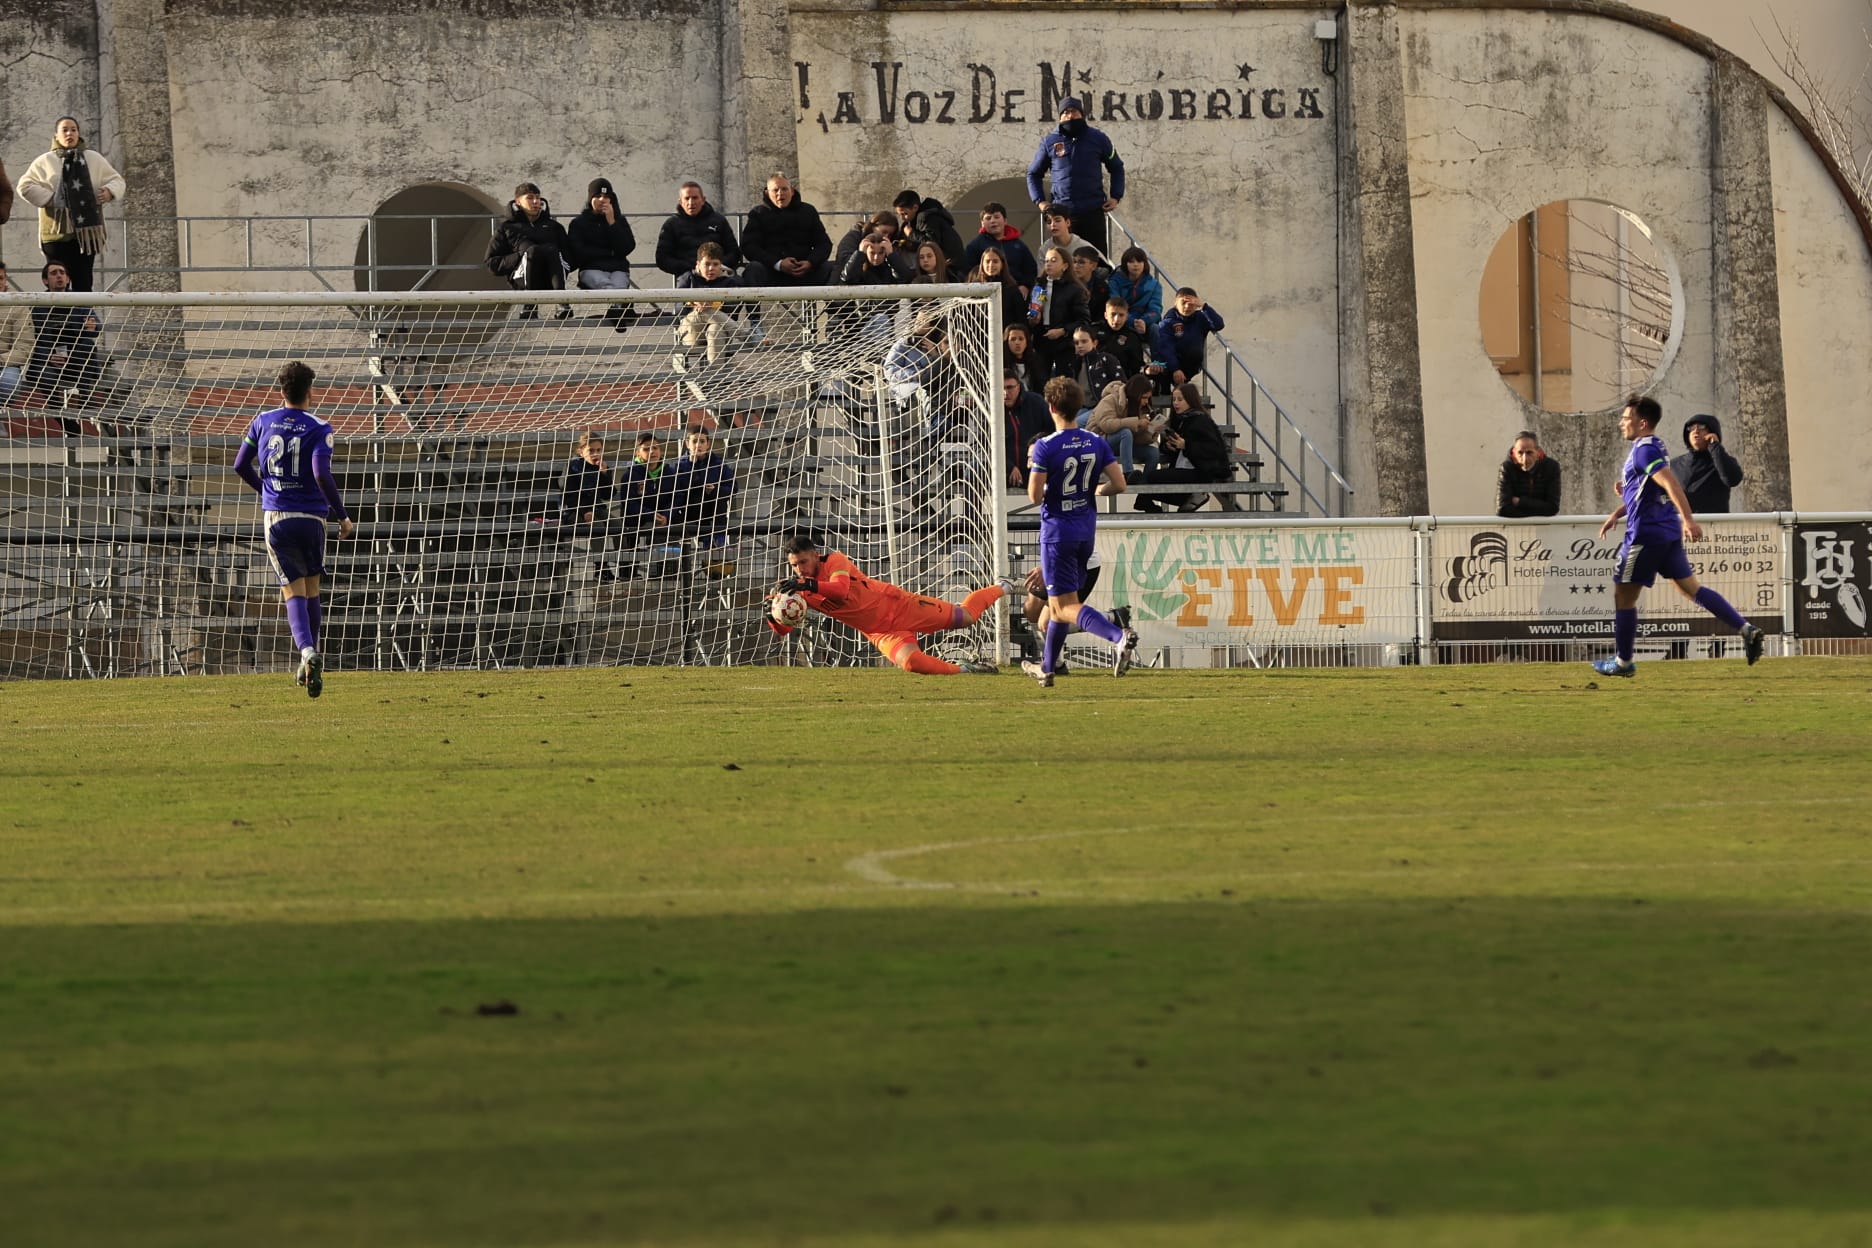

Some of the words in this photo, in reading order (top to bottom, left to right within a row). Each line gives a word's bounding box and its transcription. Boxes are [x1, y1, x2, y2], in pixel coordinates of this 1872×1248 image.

[267, 434, 301, 477] 21
[1062, 453, 1096, 496] 27
[1714, 532, 1758, 545] Portugal
[1760, 534, 1770, 542] 11
[1184, 534, 1279, 565] GIVE
[1292, 533, 1356, 564] ME
[1514, 539, 1553, 561] La
[1566, 538, 1623, 561] Bod
[1714, 544, 1755, 557] Rodrigo
[1757, 543, 1778, 554] (Sa)
[1689, 562, 1705, 576] 23
[1708, 559, 1729, 575] 46
[1733, 560, 1753, 573] 00
[1756, 560, 1774, 574] 32
[1177, 566, 1365, 627] FIVE
[1804, 601, 1832, 609] desde
[1808, 611, 1828, 620] 1915
[1527, 621, 1690, 635] www.hotellabega.com
